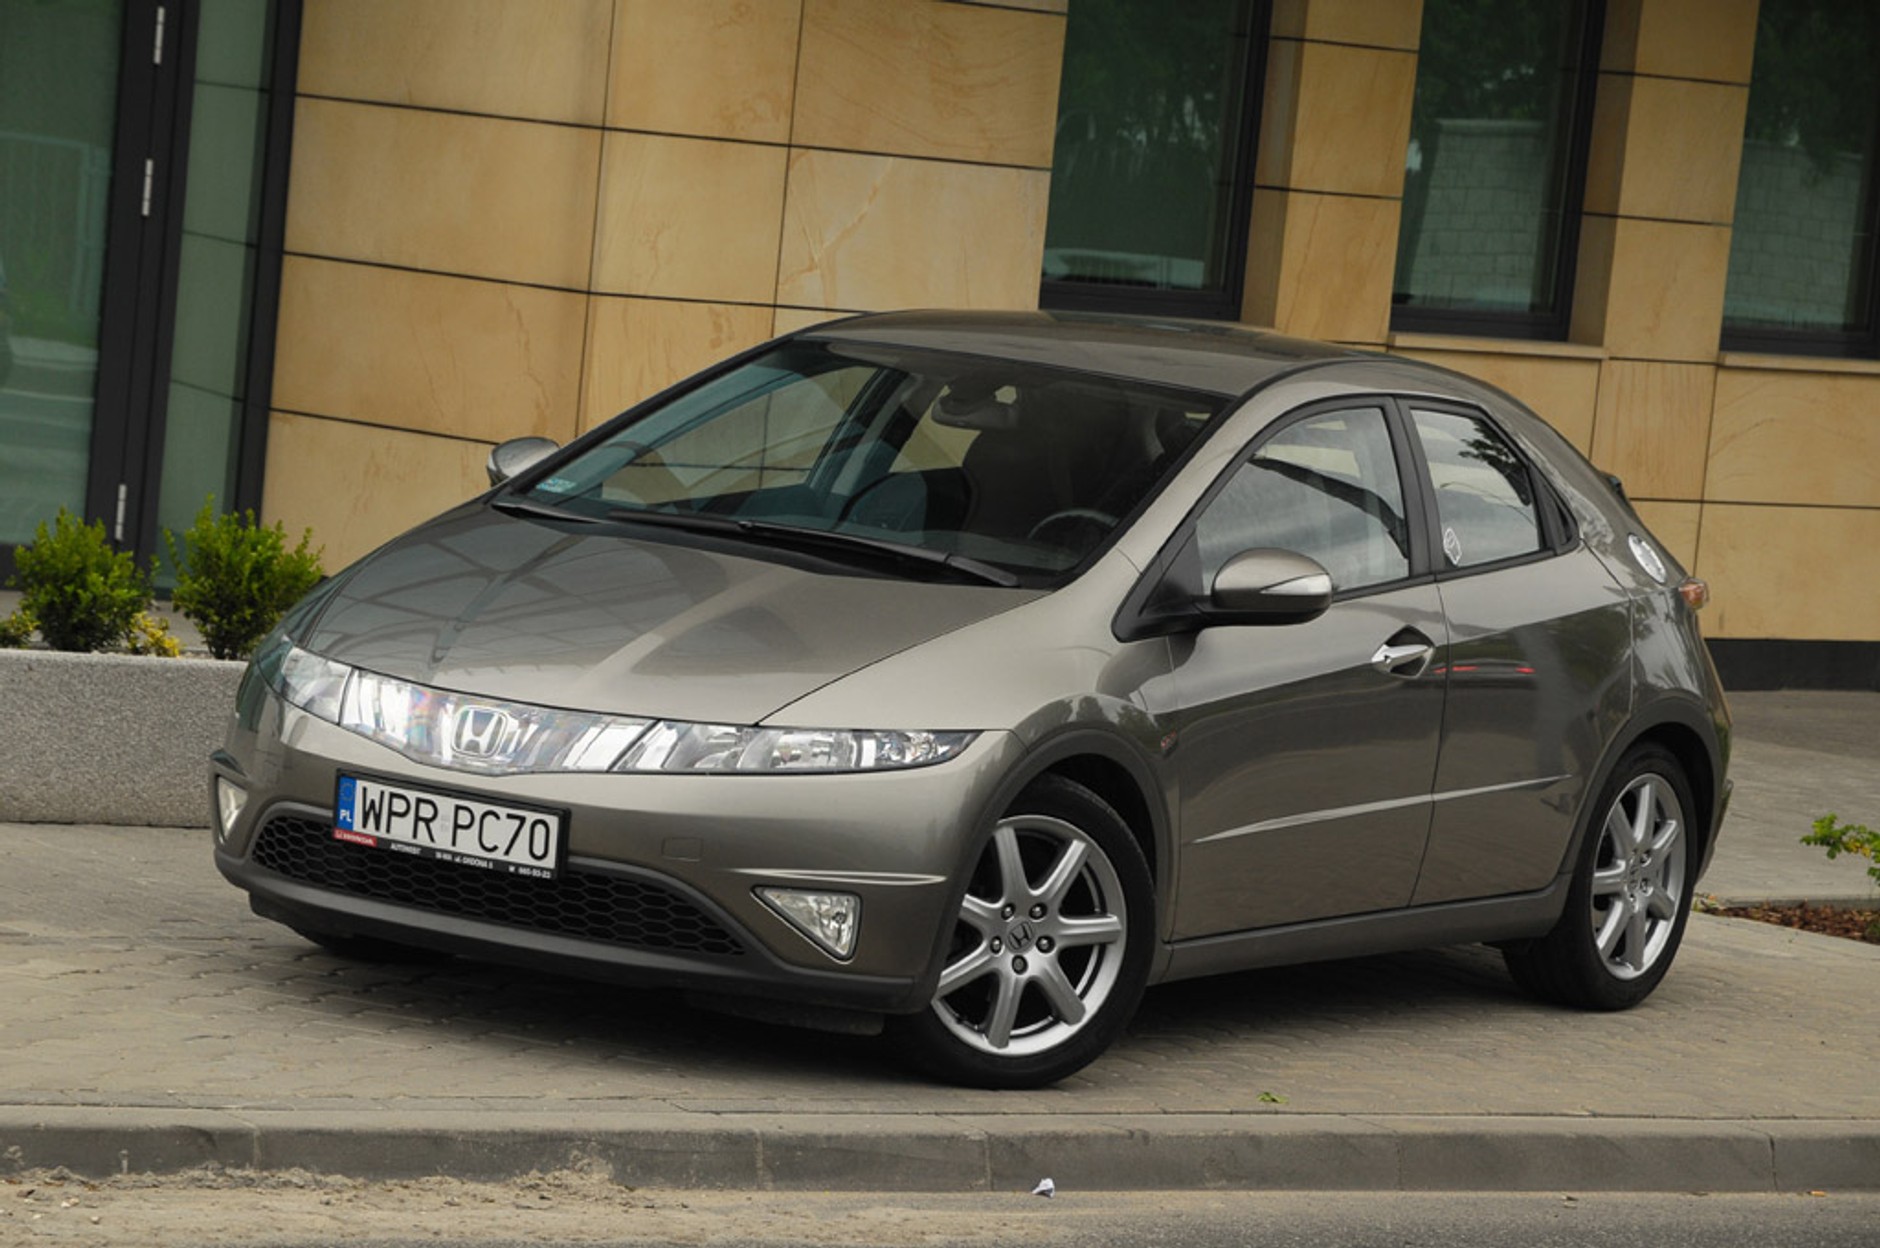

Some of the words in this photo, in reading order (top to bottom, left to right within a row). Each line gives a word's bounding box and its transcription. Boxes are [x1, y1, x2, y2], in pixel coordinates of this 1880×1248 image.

[340, 809, 353, 823] PL
[361, 785, 439, 843] WPR
[451, 803, 550, 861] PC70
